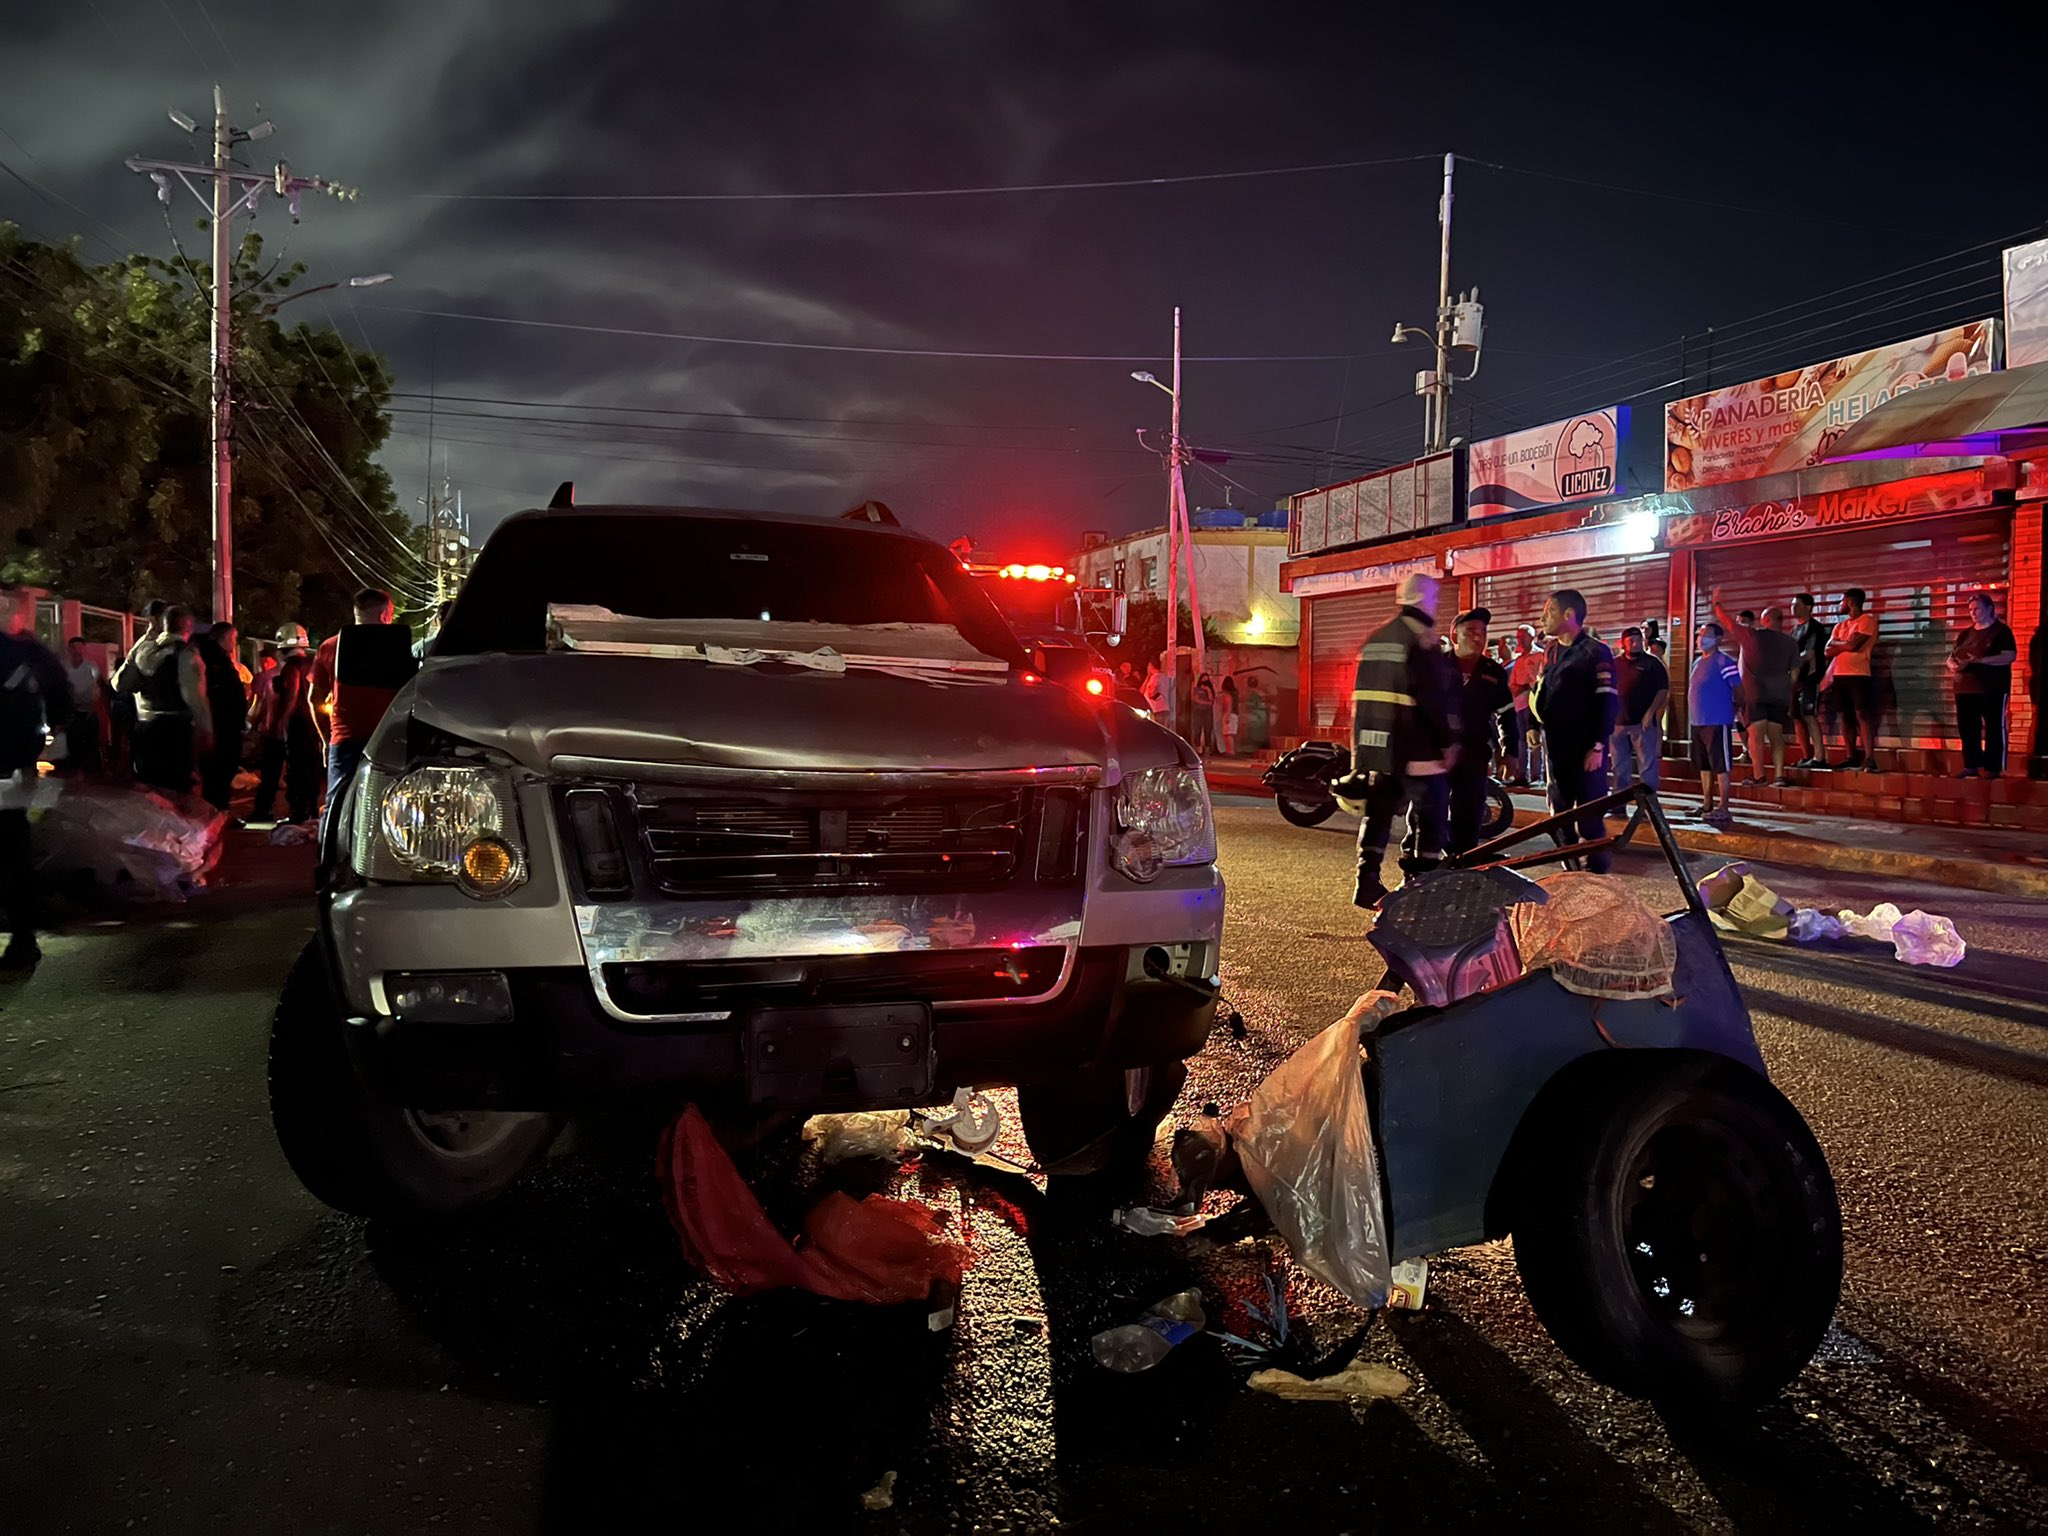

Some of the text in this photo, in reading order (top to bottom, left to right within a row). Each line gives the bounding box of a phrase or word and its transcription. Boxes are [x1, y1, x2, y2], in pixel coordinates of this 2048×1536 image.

[1701, 380, 1824, 431] PANADERÍA
[1702, 416, 1799, 452] VIVERES y más
[1565, 468, 1607, 495] LICOVEZ
[1713, 504, 1806, 537] Bracho's
